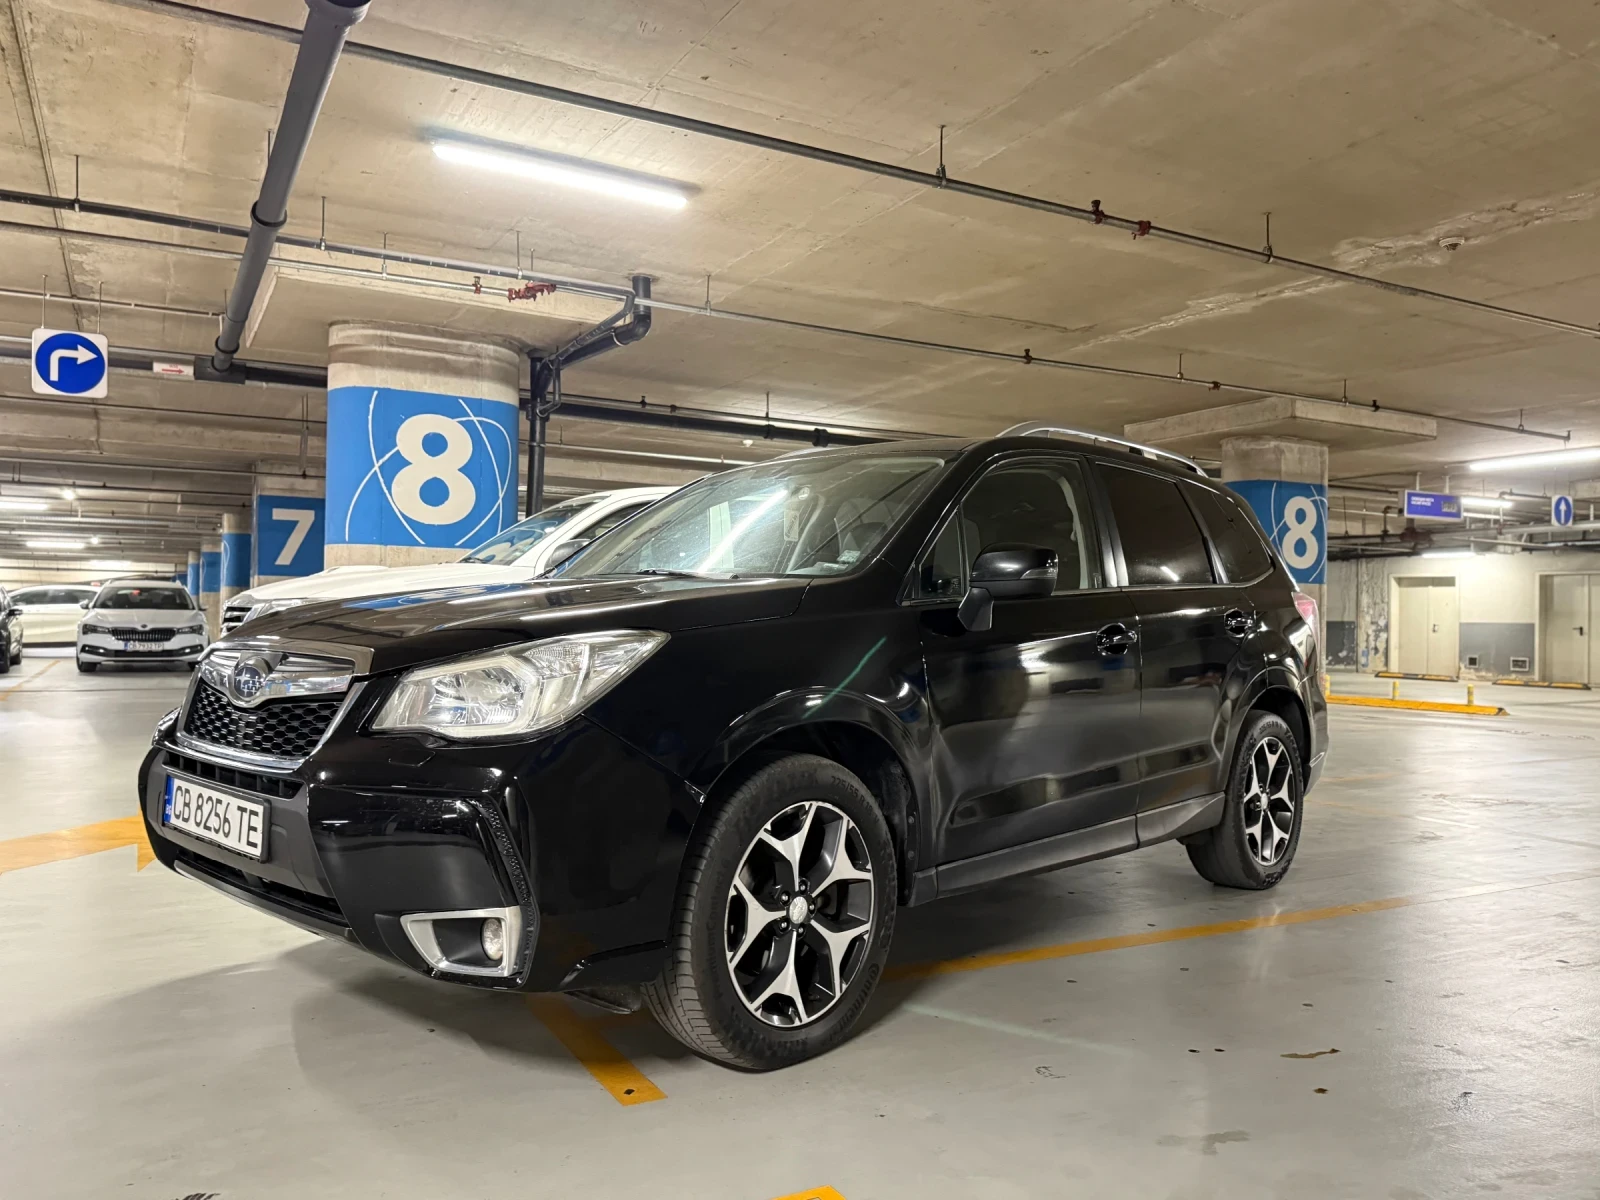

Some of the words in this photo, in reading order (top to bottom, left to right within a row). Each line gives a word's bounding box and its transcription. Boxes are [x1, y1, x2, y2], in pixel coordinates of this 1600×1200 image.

[391, 413, 476, 525] 8
[272, 508, 315, 566] 7
[1282, 495, 1319, 569] 8
[173, 785, 192, 823] CB
[194, 792, 231, 838] 8256
[237, 805, 259, 849] TE
